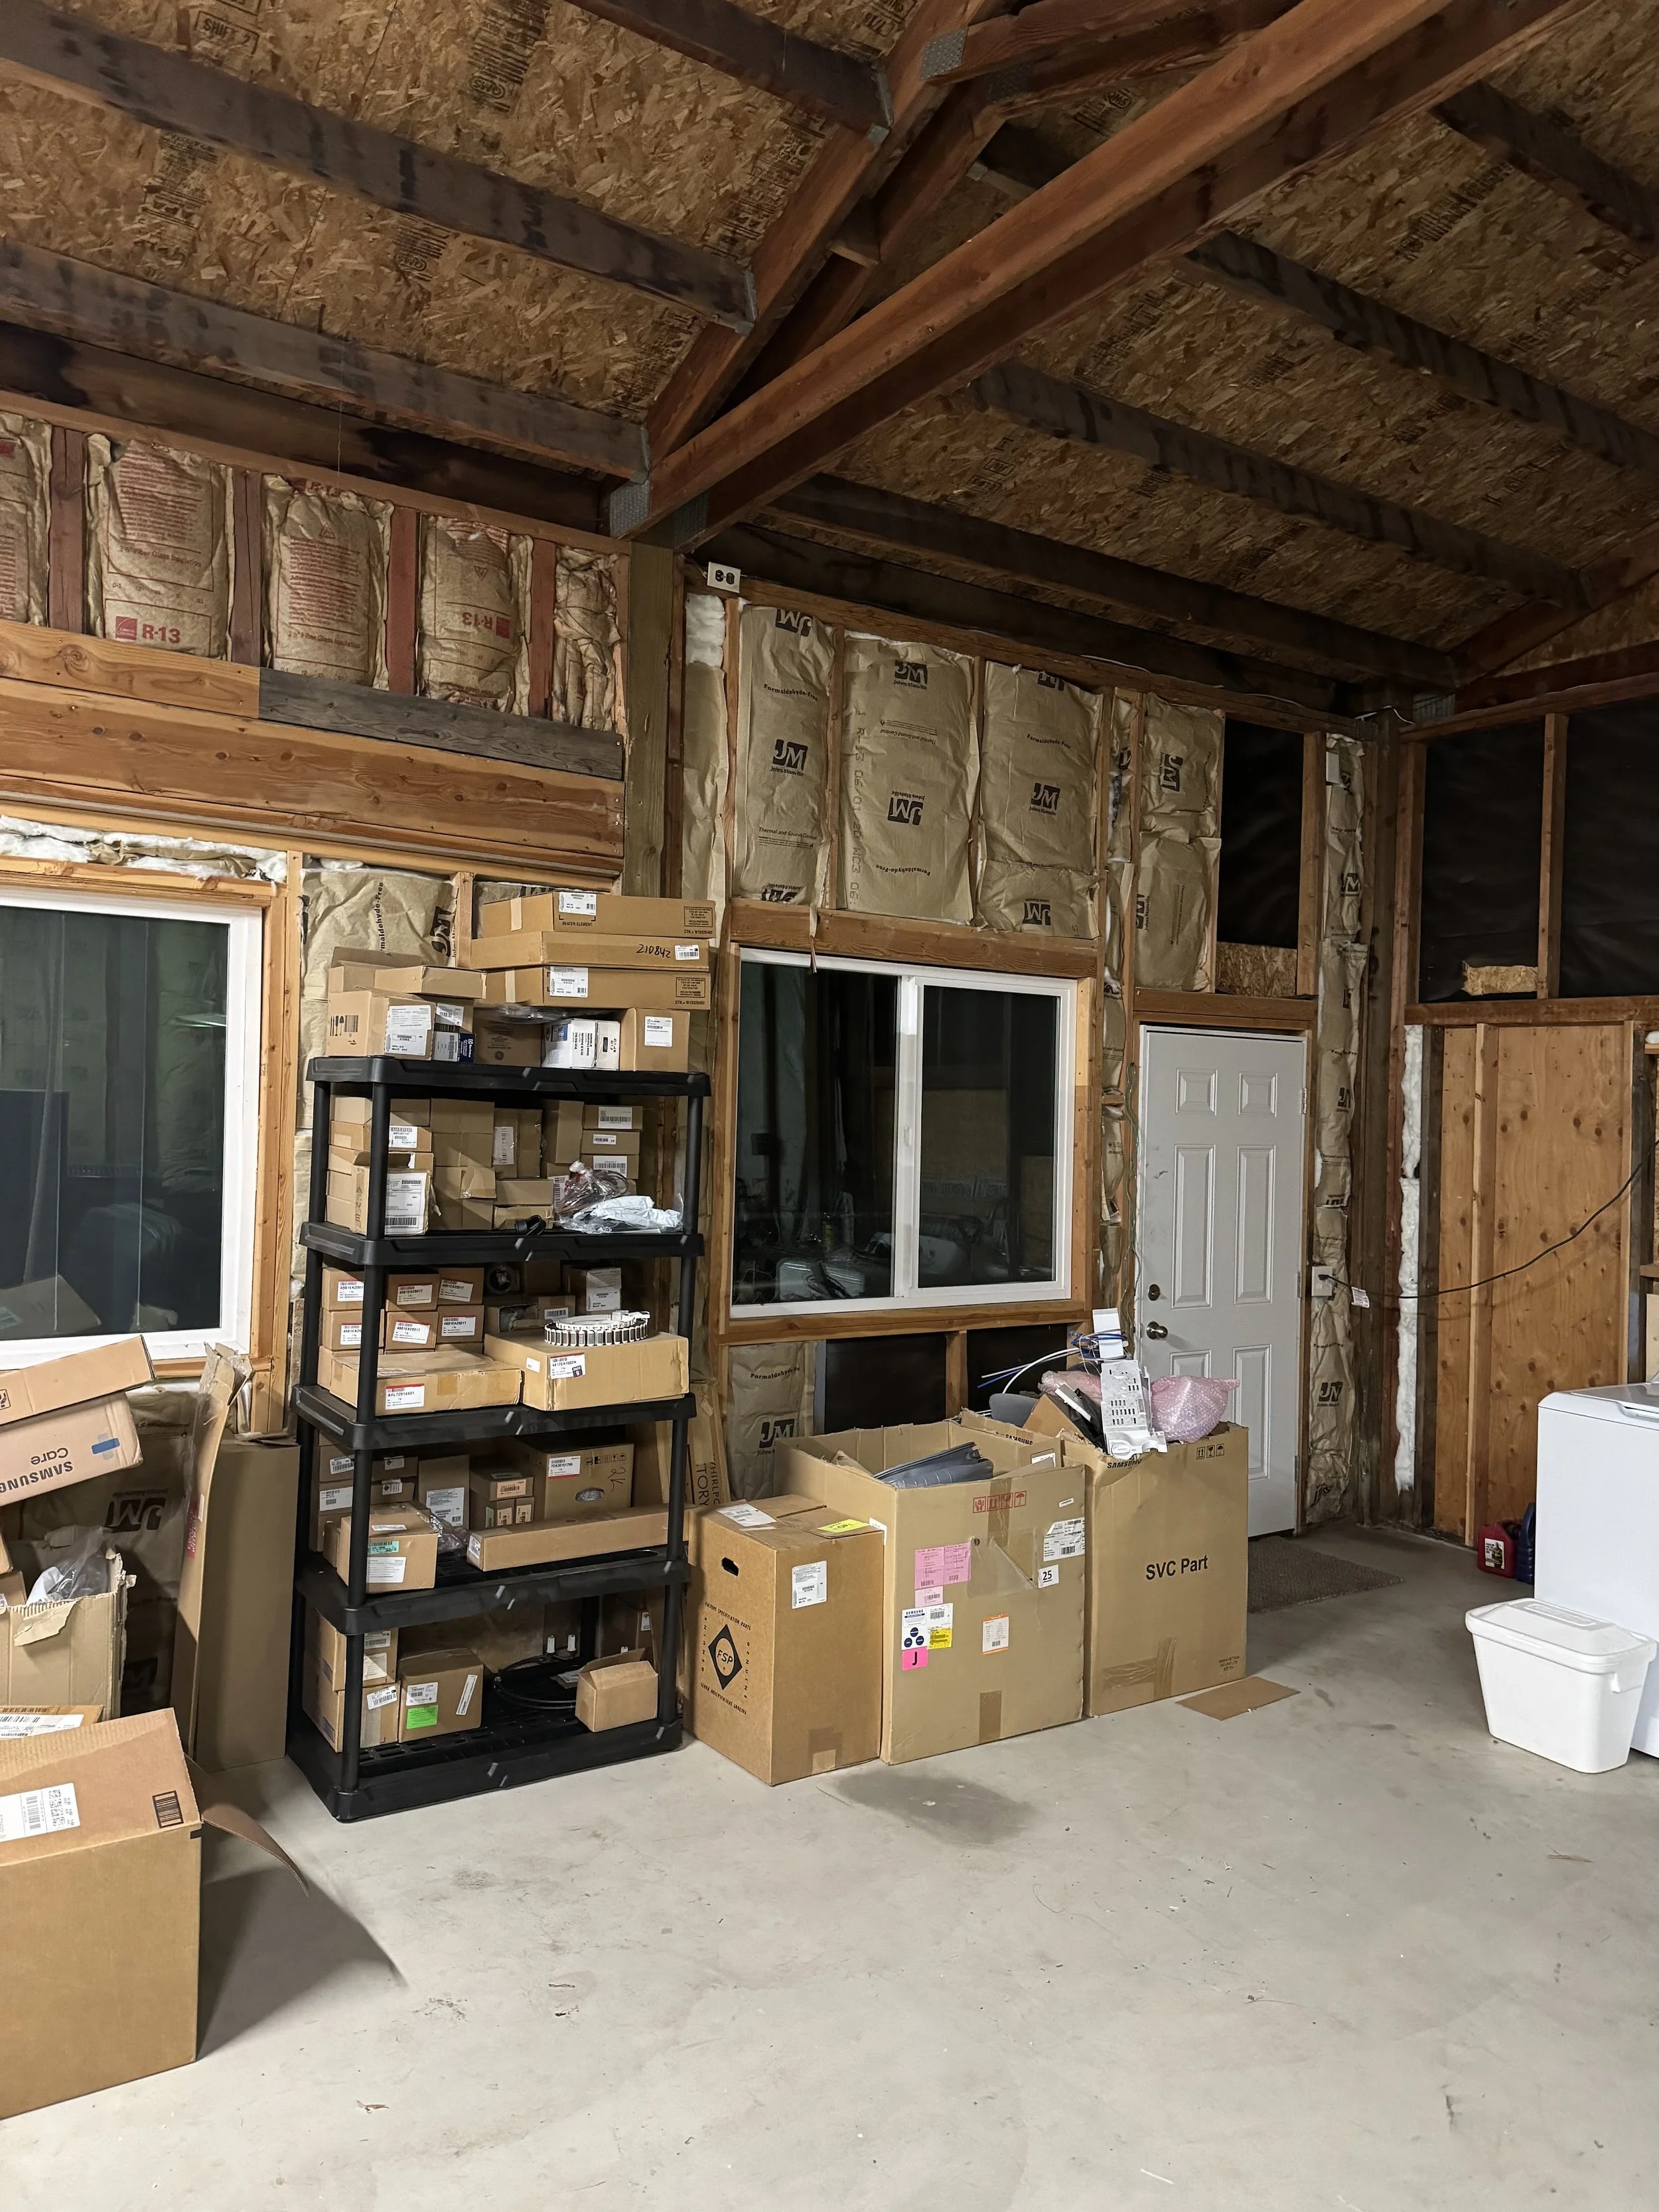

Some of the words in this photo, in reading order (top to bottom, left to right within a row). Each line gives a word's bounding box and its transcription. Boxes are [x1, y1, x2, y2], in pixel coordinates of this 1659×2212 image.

[462, 611, 492, 630] R-13
[142, 623, 181, 644] R-13
[301, 630, 317, 641] Fiber
[895, 660, 928, 684] JM
[772, 739, 809, 772] JM
[1031, 782, 1061, 810] JM
[887, 797, 924, 826] JM
[1023, 903, 1052, 926] JM
[31, 1447, 69, 1465] Care
[695, 1465, 709, 1507] TORY
[104, 1497, 166, 1534] JM
[1042, 1570, 1052, 1581] 25
[1145, 1560, 1177, 1581] SVC
[1181, 1554, 1209, 1575] Part
[717, 1649, 733, 1664] FSP
[912, 1651, 918, 1666] J
